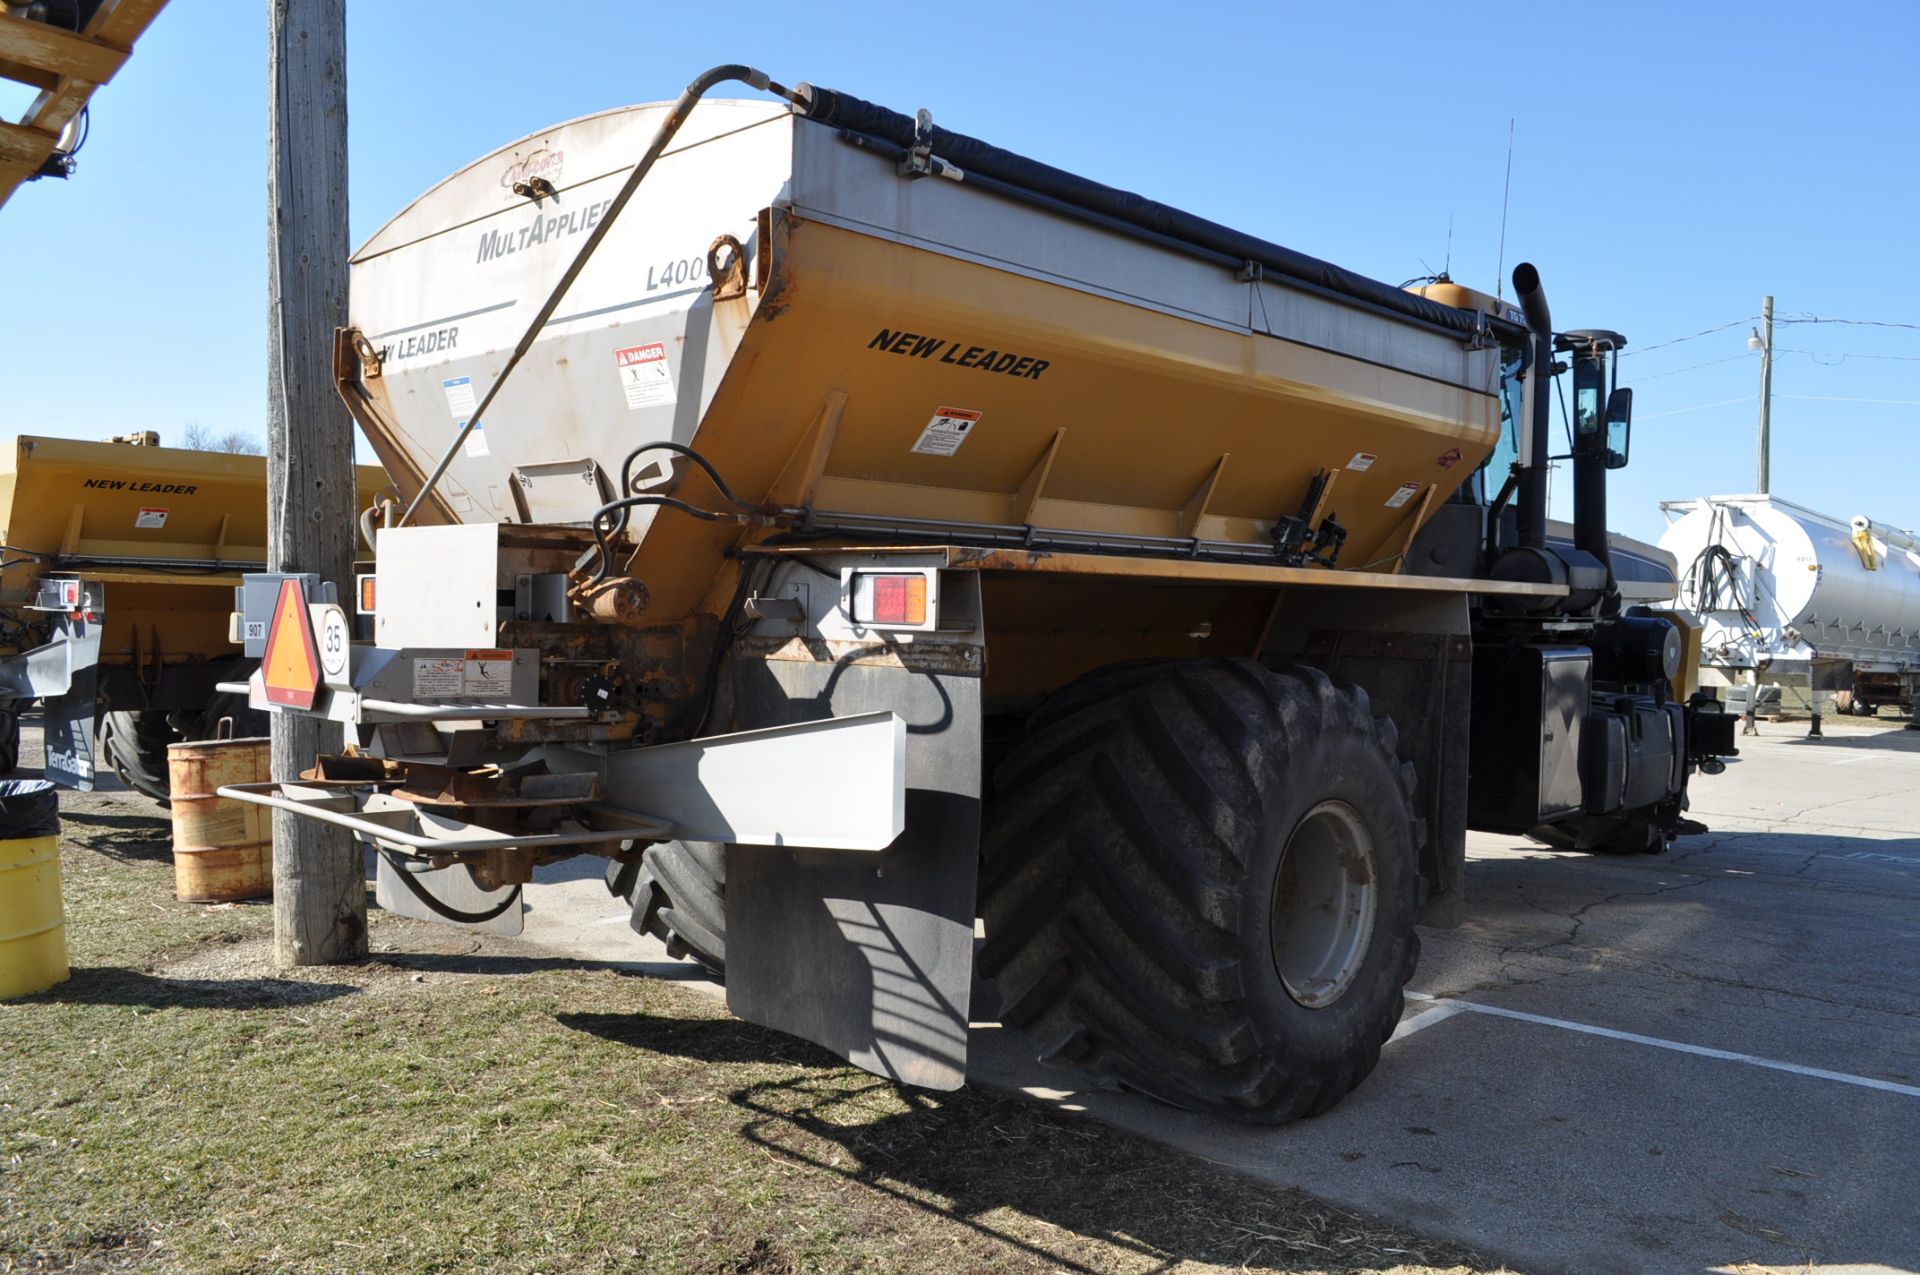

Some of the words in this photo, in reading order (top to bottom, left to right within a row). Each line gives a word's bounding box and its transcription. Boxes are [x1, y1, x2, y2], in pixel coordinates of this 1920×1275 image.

[646, 256, 711, 291] L400
[398, 327, 459, 360] LEADER
[627, 347, 664, 363] DANGER
[867, 328, 946, 359] NEW
[940, 343, 1050, 380] LEADER
[84, 479, 126, 490] NEW
[129, 482, 198, 495] LEADER
[248, 624, 262, 637] 907
[326, 625, 341, 652] 35
